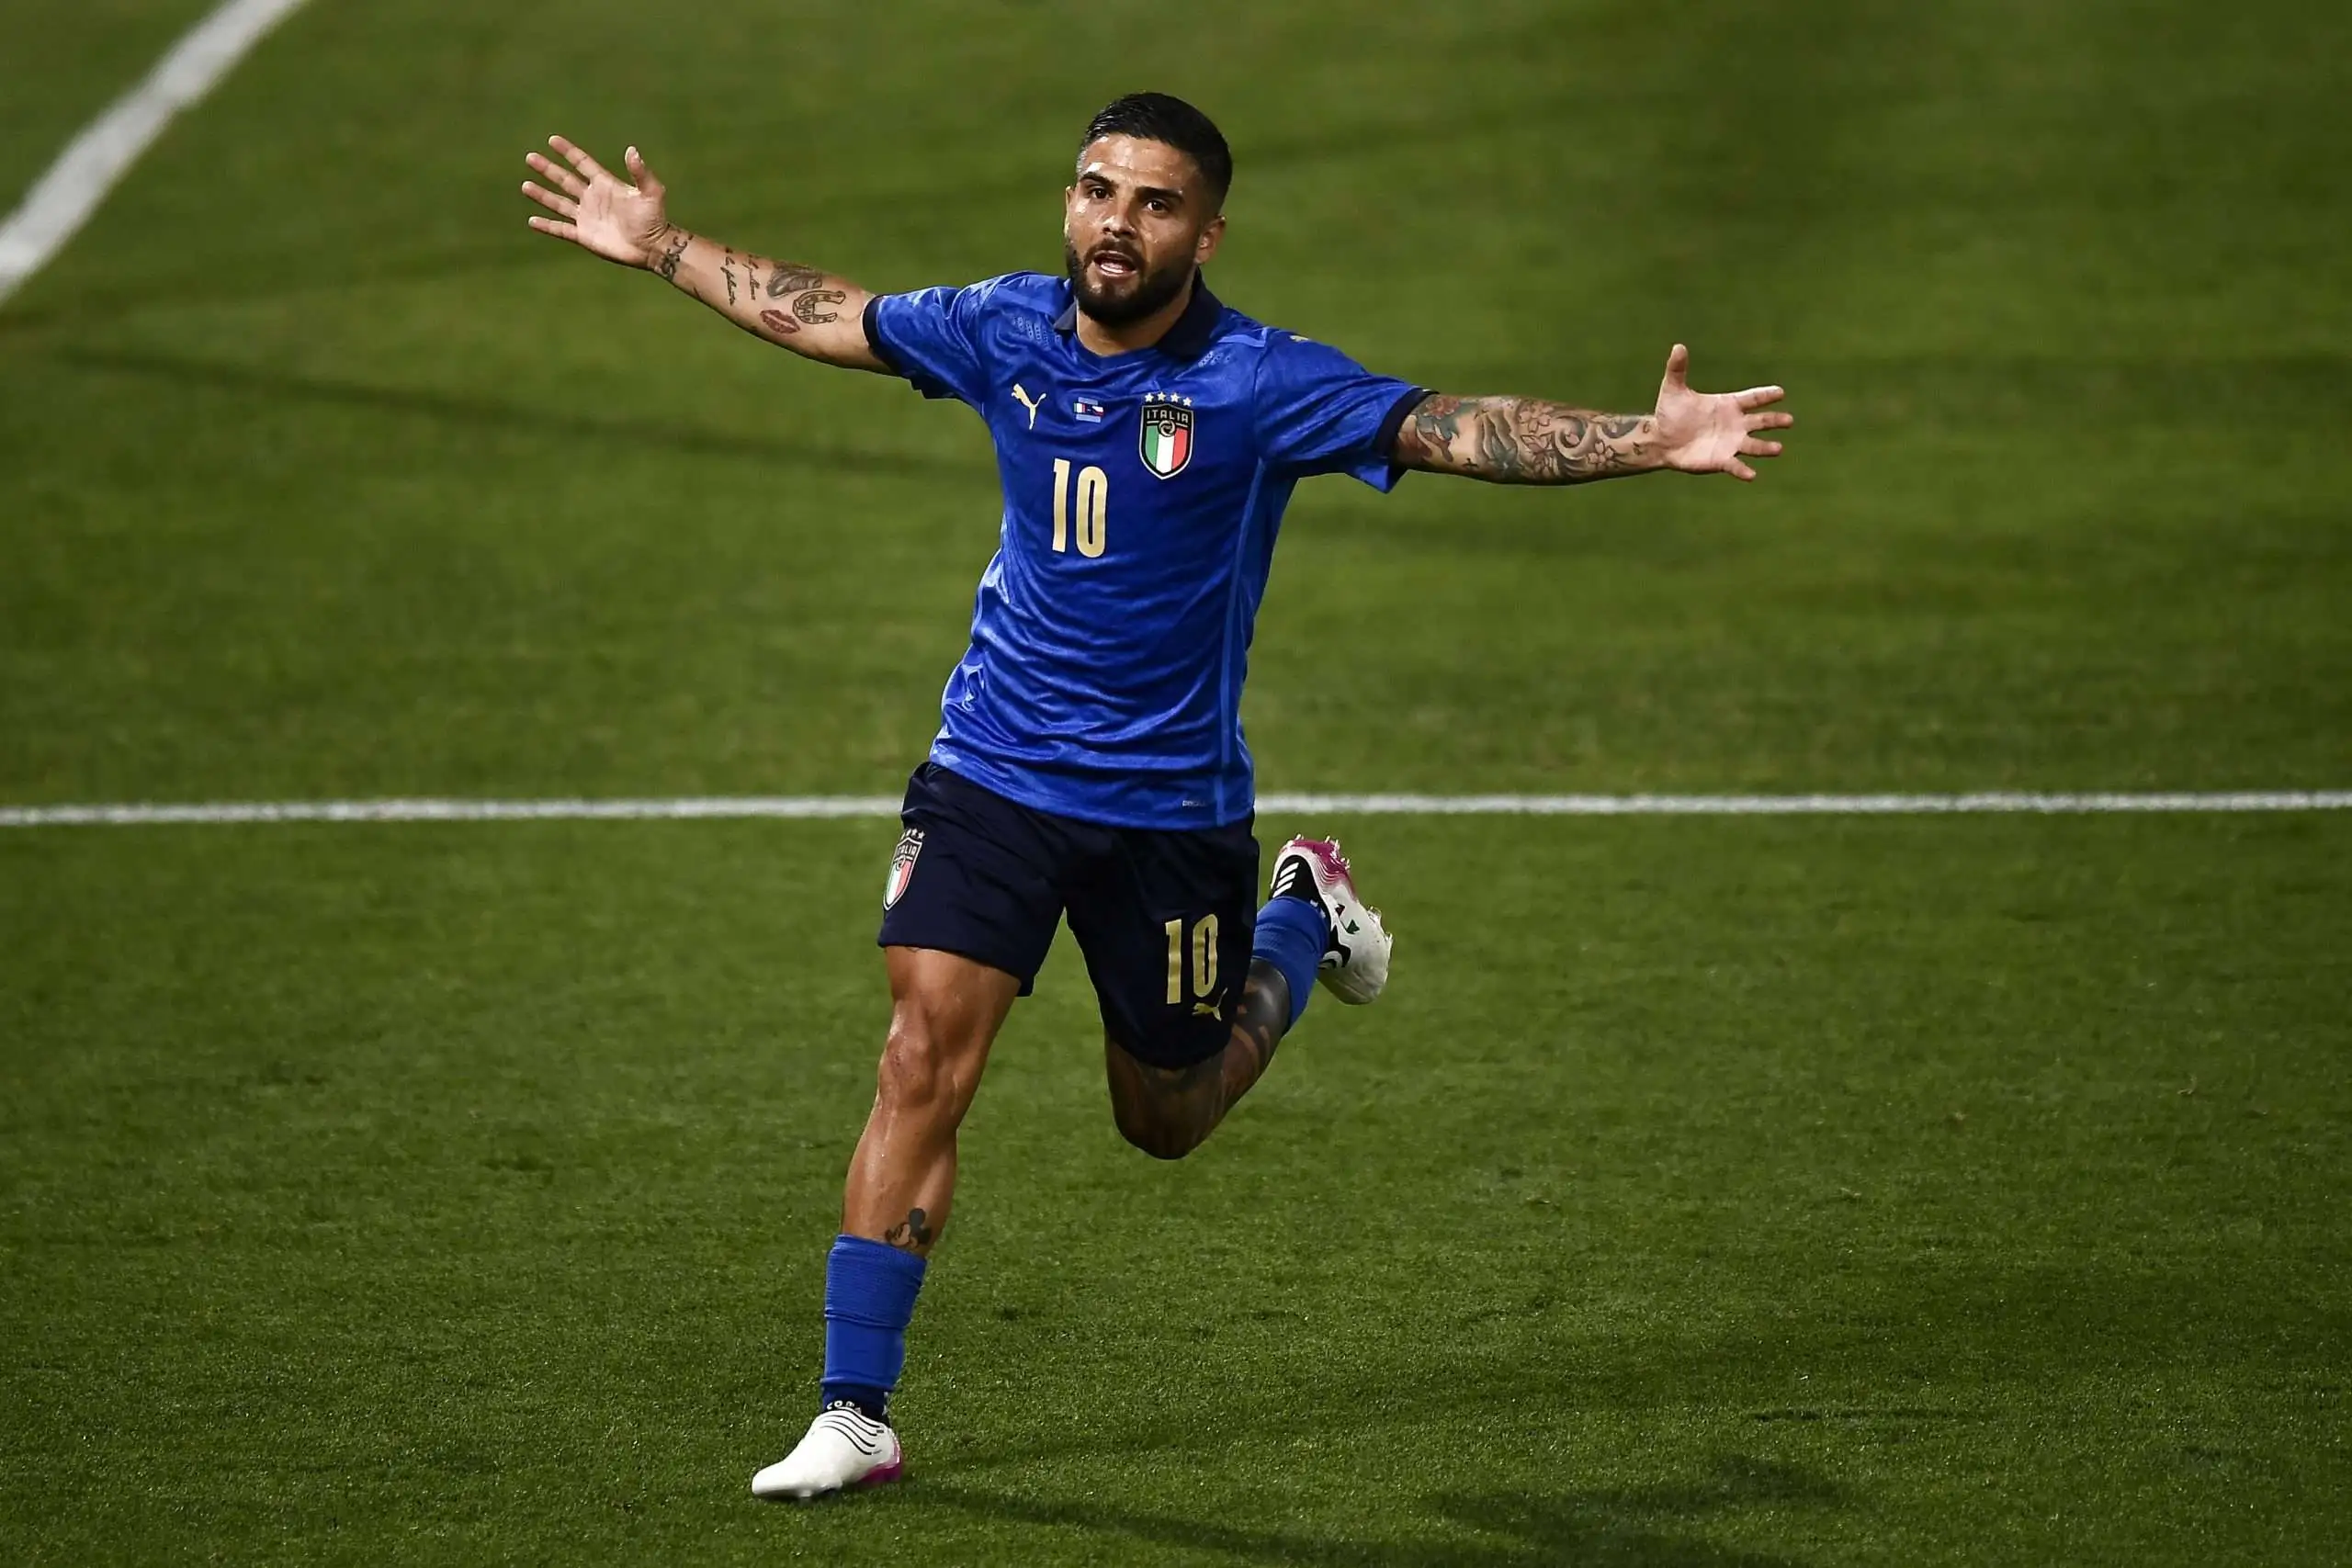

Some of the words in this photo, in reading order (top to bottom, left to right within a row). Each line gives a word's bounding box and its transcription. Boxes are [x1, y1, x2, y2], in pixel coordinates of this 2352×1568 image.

[1147, 409, 1189, 423] ITALIA
[1053, 458, 1108, 558] 10
[1165, 914, 1218, 1004] 10
